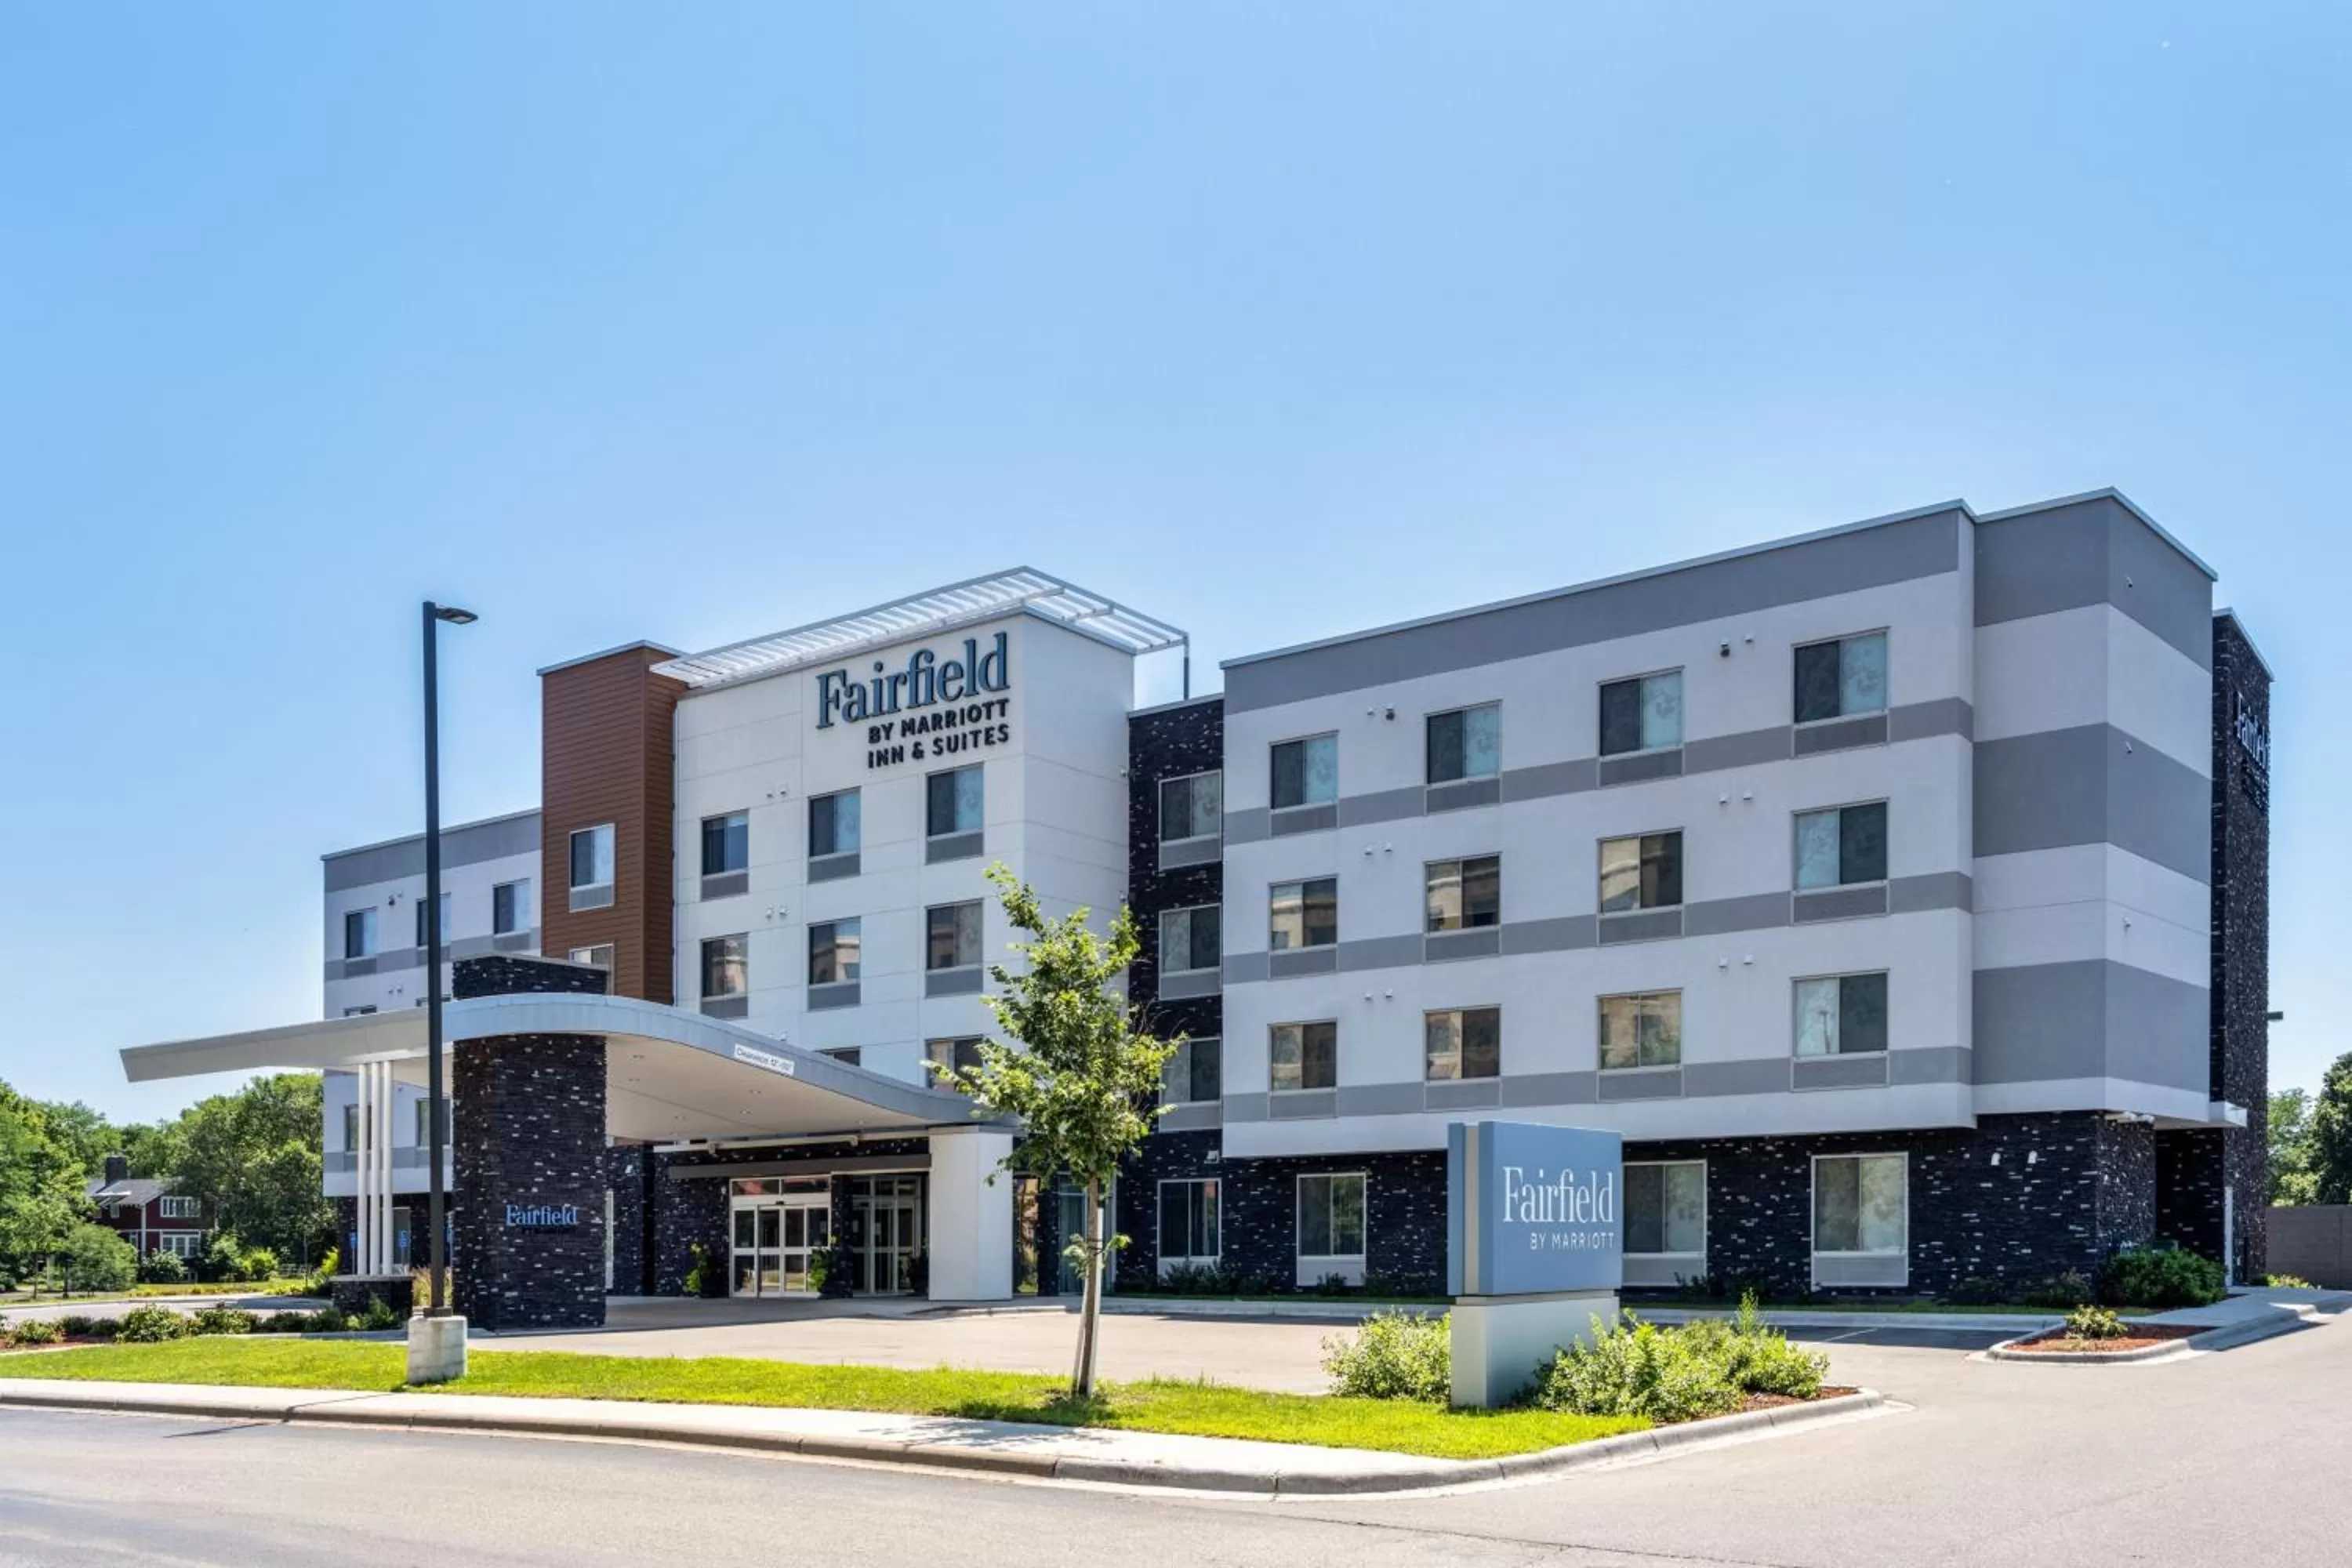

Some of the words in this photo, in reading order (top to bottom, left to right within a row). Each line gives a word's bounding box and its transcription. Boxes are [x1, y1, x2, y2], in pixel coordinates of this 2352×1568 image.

[815, 632, 1010, 729] Fairfield
[868, 722, 895, 744] BY
[901, 699, 1010, 738] MARRIOTT
[868, 746, 904, 768] INN
[912, 742, 924, 760] &
[933, 724, 1010, 757] SUITES
[505, 1203, 579, 1226] Fairfield
[1503, 1166, 1614, 1223] Fairfield
[1530, 1232, 1547, 1250] BY
[1552, 1232, 1615, 1250] MARRIOTT
